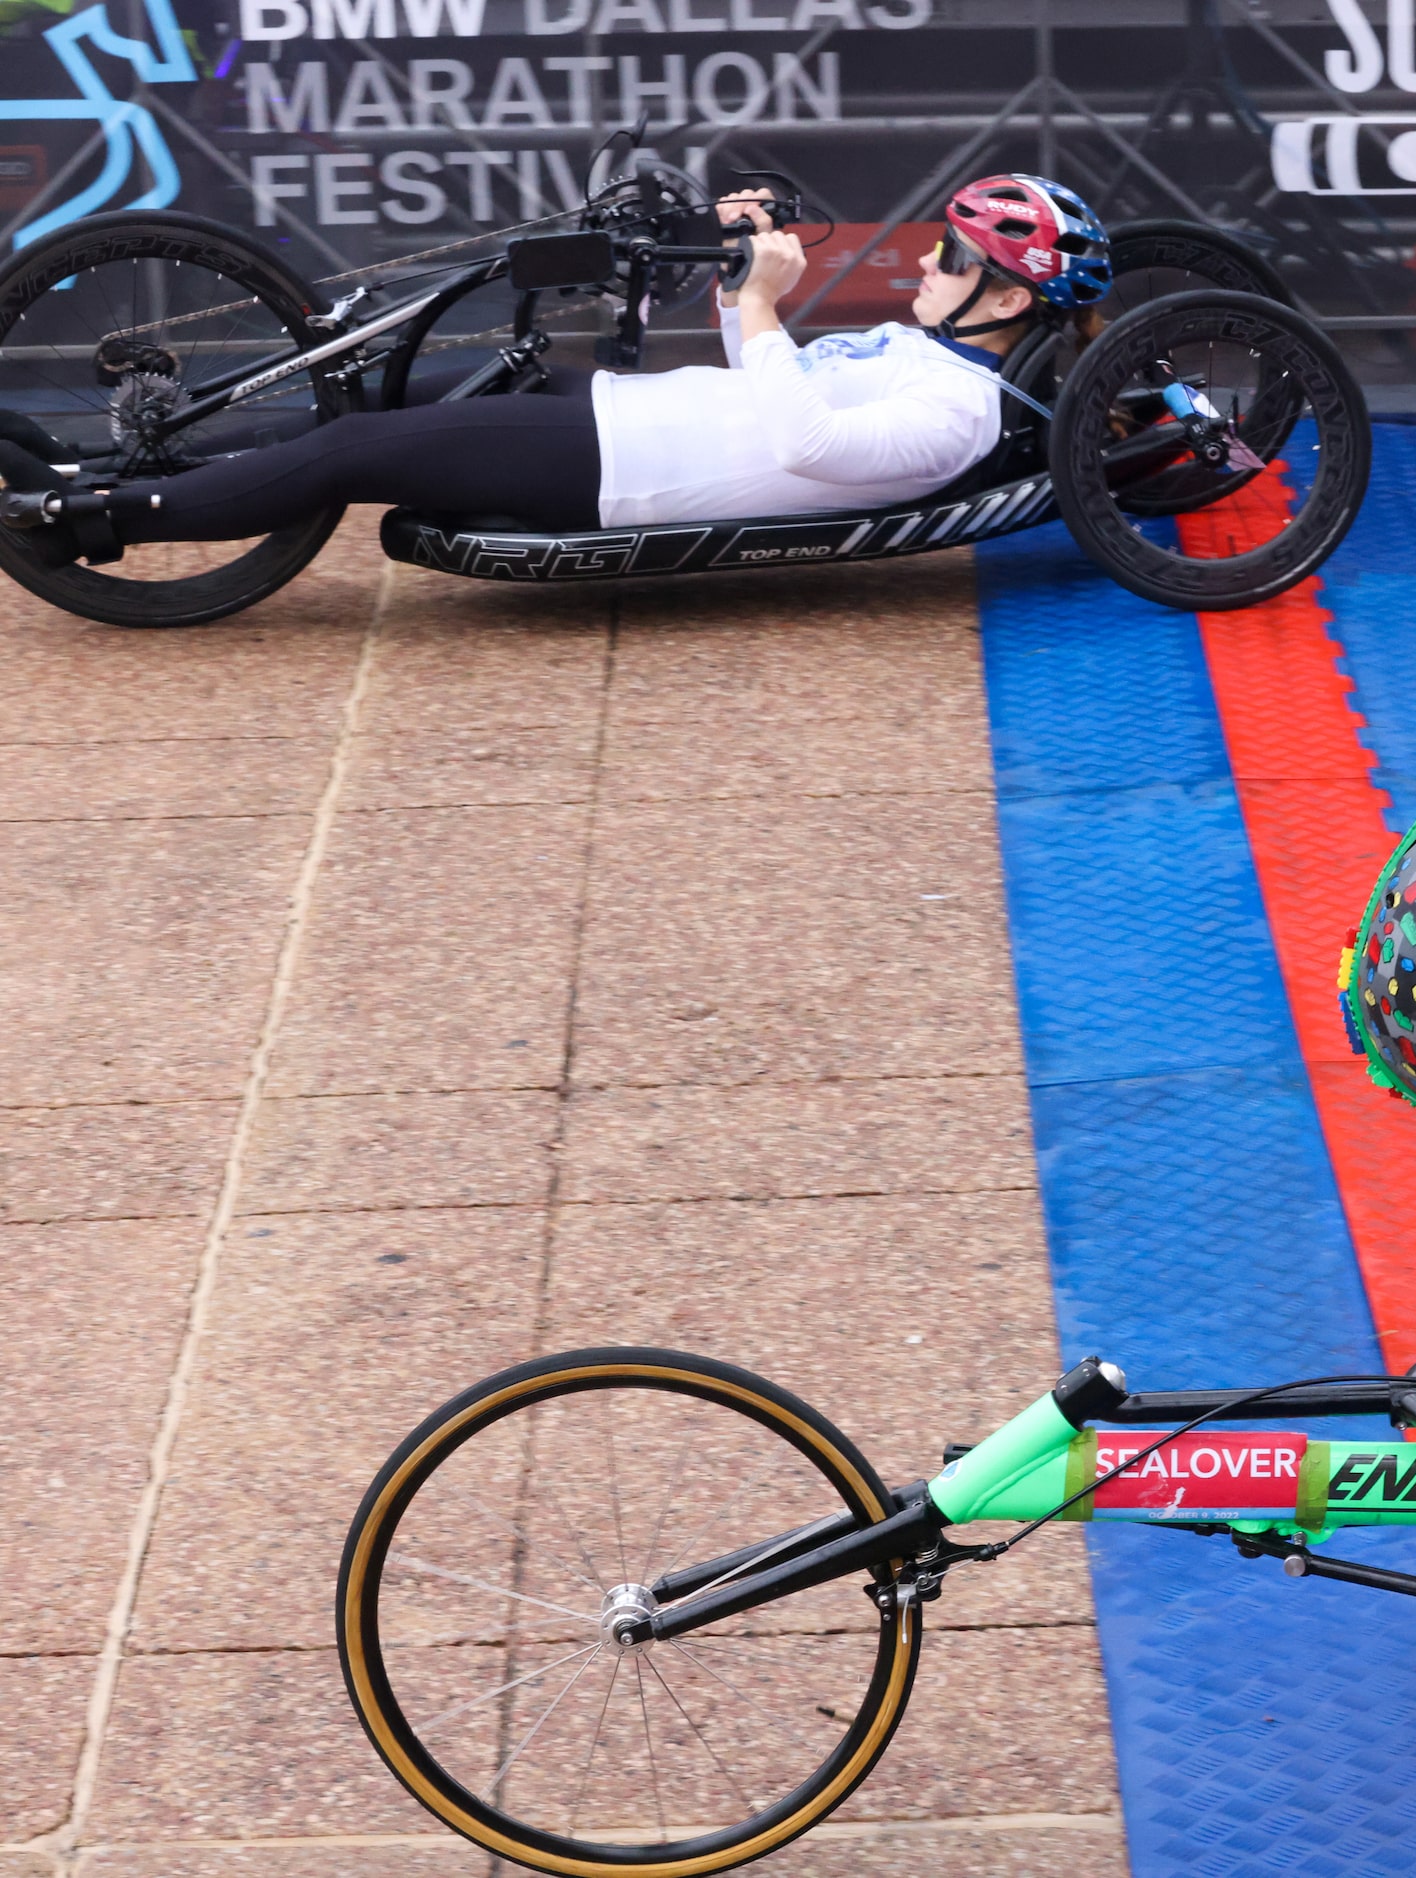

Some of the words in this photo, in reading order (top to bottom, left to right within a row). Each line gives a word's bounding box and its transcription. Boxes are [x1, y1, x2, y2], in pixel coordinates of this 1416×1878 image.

[240, 0, 487, 41] BMW
[245, 51, 843, 134] MARATHON
[987, 200, 1040, 216] RUDY
[739, 548, 781, 561] TOP
[785, 544, 831, 559] END
[1095, 1448, 1297, 1478] SEALOVER
[1148, 1511, 1199, 1520] OCOBER
